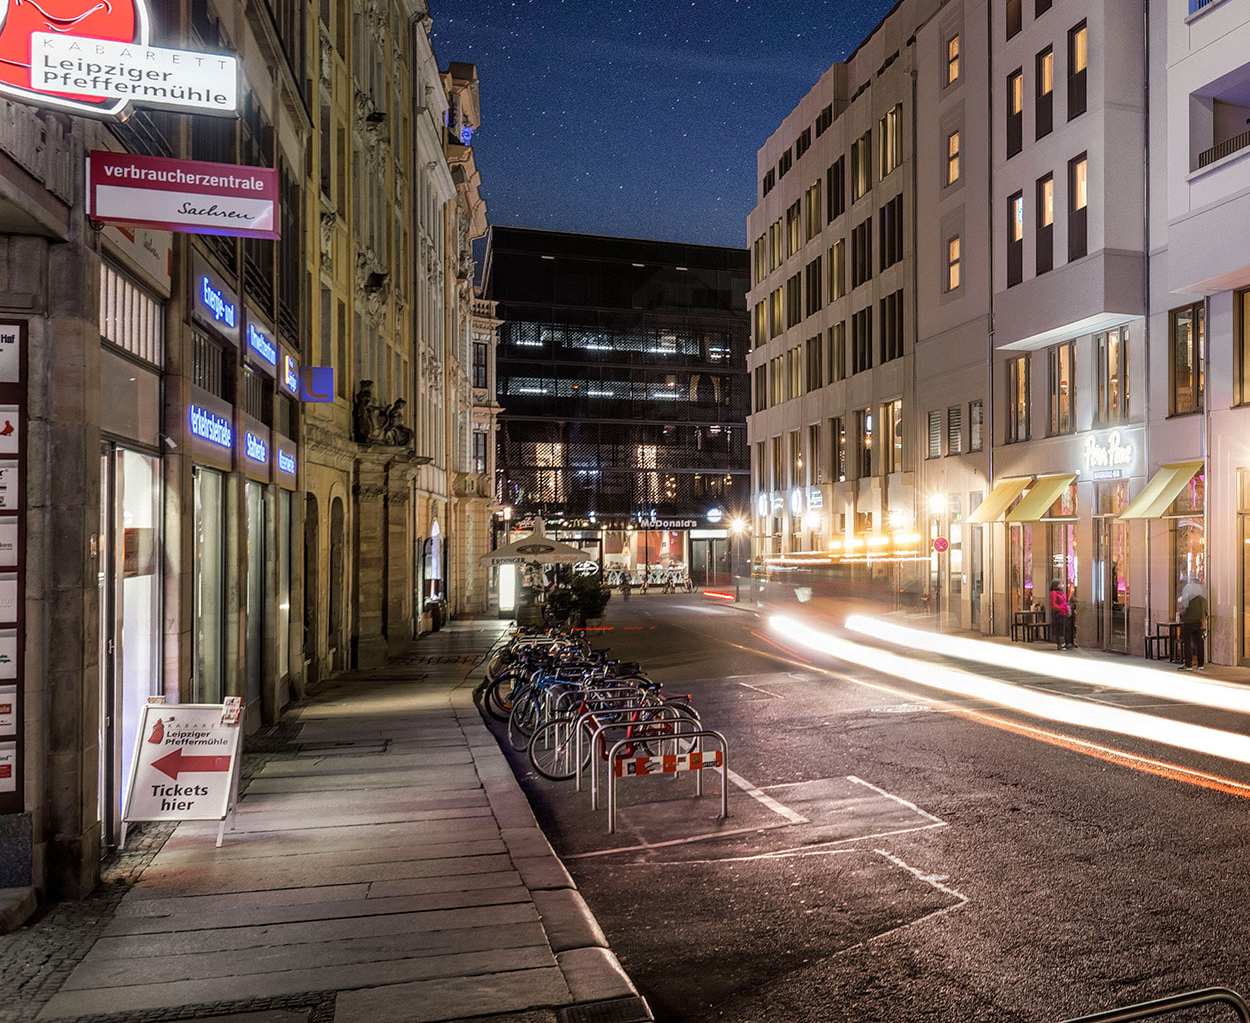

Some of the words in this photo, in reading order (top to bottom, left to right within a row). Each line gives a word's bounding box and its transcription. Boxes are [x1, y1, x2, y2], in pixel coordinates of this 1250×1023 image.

[43, 38, 227, 70] KABARETT
[44, 55, 173, 82] Leipziger
[43, 71, 227, 104] Pfeffermühle
[104, 164, 264, 191] verbraucherzentrale
[177, 202, 255, 220] Sachsen
[640, 518, 697, 528] McDonald's
[491, 557, 526, 565] ERDINGER
[166, 730, 211, 739] Leipziger
[165, 738, 228, 746] Pfeffermühle
[151, 784, 209, 797] Tickets
[160, 798, 195, 812] hier
